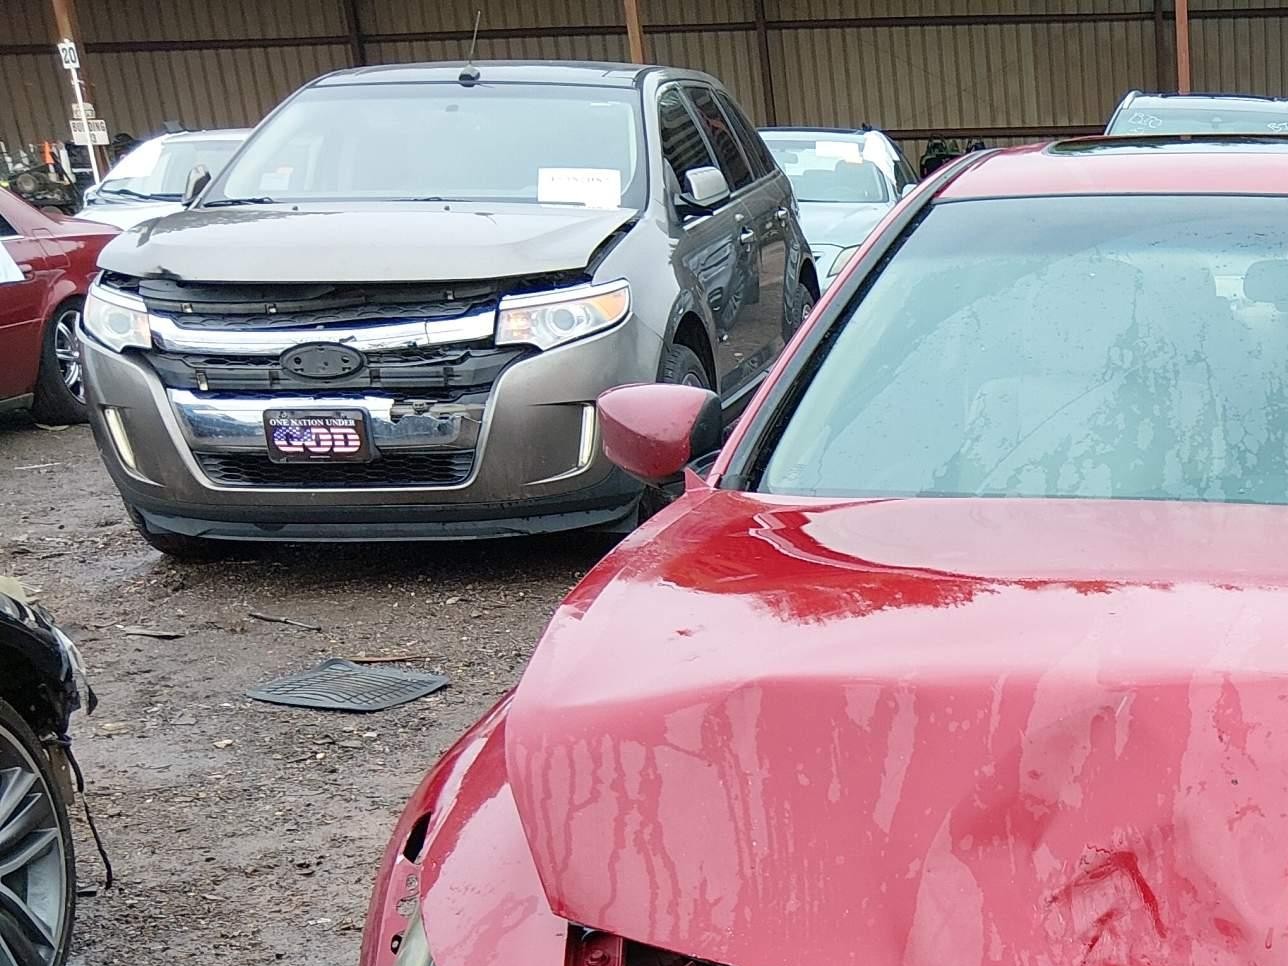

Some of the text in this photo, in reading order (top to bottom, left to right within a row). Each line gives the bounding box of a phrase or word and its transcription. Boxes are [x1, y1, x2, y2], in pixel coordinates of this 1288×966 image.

[62, 47, 77, 63] 20
[71, 121, 106, 132] BUIDING
[269, 418, 355, 426] ONE NATION UNDER
[272, 426, 361, 453] GOD
